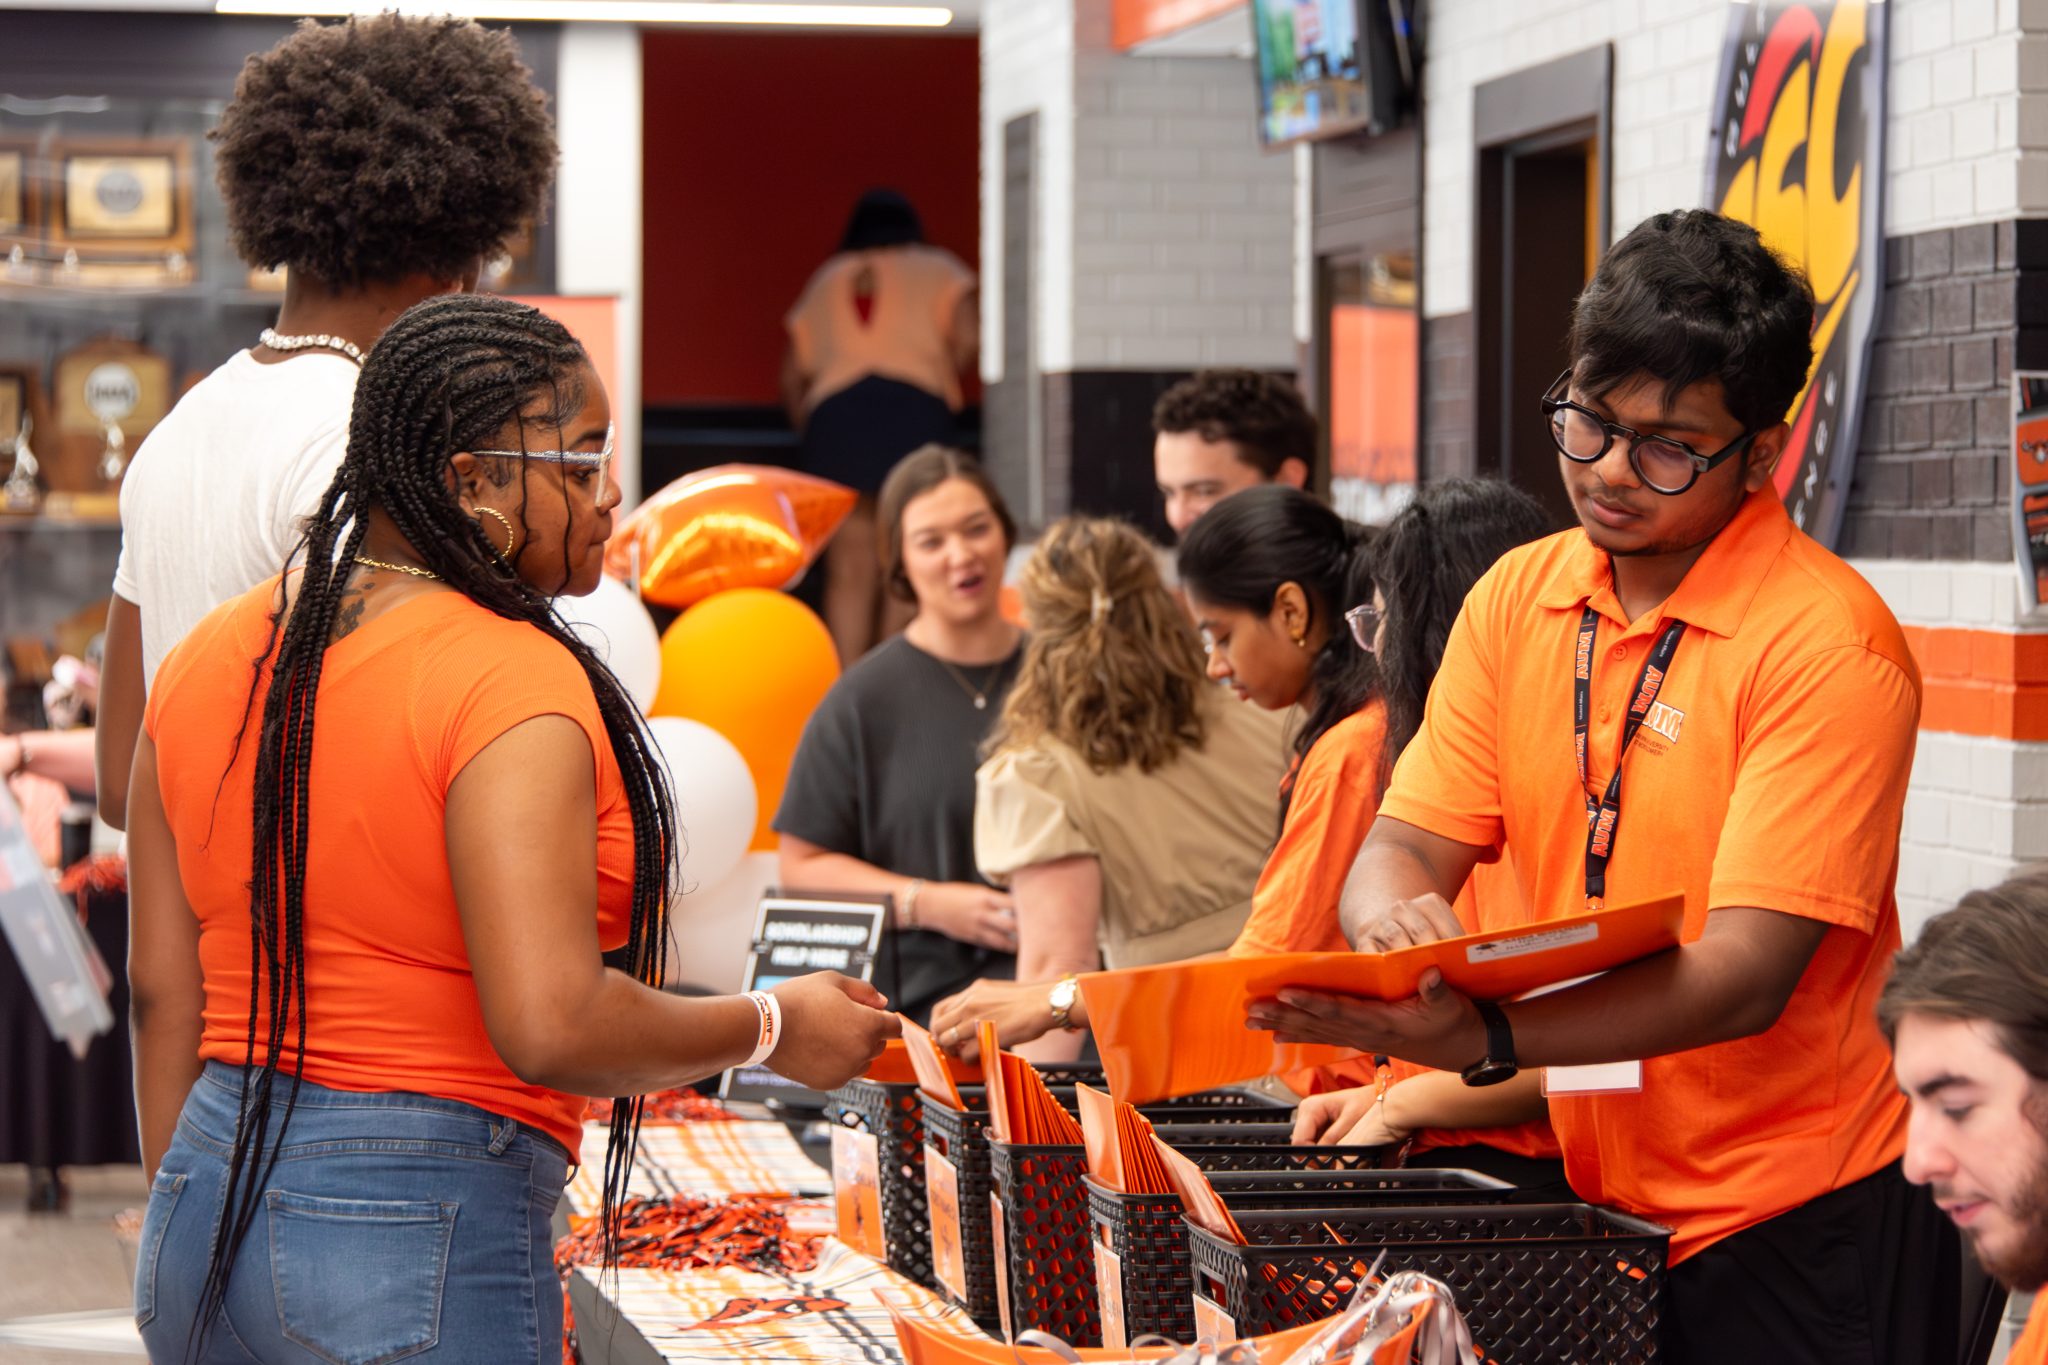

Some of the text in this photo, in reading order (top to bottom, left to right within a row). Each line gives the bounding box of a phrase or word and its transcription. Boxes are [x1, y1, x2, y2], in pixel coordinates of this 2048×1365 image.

[1576, 630, 1594, 680] AUM
[1631, 665, 1664, 713] AUM
[1591, 808, 1617, 857] AUM
[764, 922, 868, 945] SCHOLARSHIP
[771, 945, 849, 969] HELP HERE
